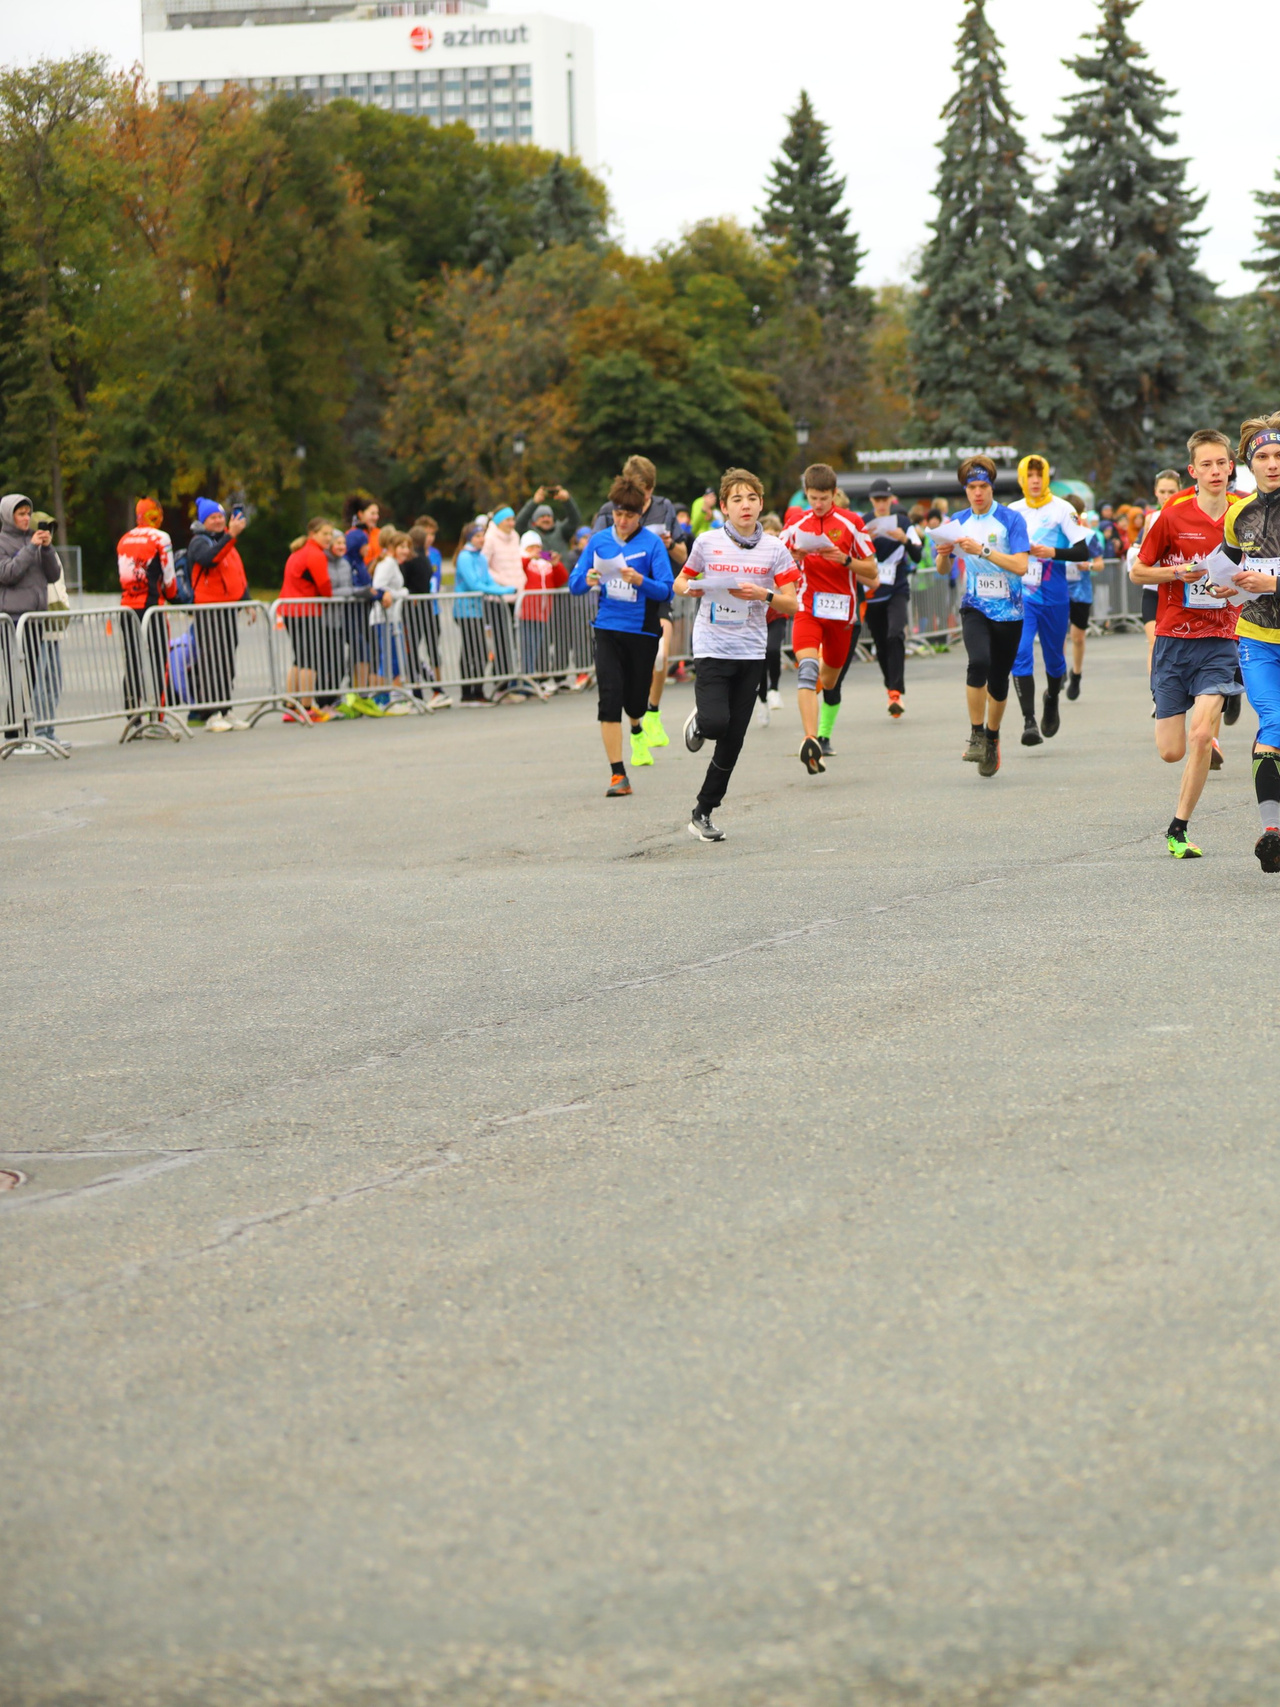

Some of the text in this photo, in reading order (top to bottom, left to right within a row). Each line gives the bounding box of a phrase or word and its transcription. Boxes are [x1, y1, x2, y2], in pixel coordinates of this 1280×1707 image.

[443, 23, 528, 47] azimut
[708, 564, 739, 573] NORD
[978, 580, 1003, 589] 305.1
[1191, 584, 1206, 595] 32
[818, 599, 843, 610] 322.1
